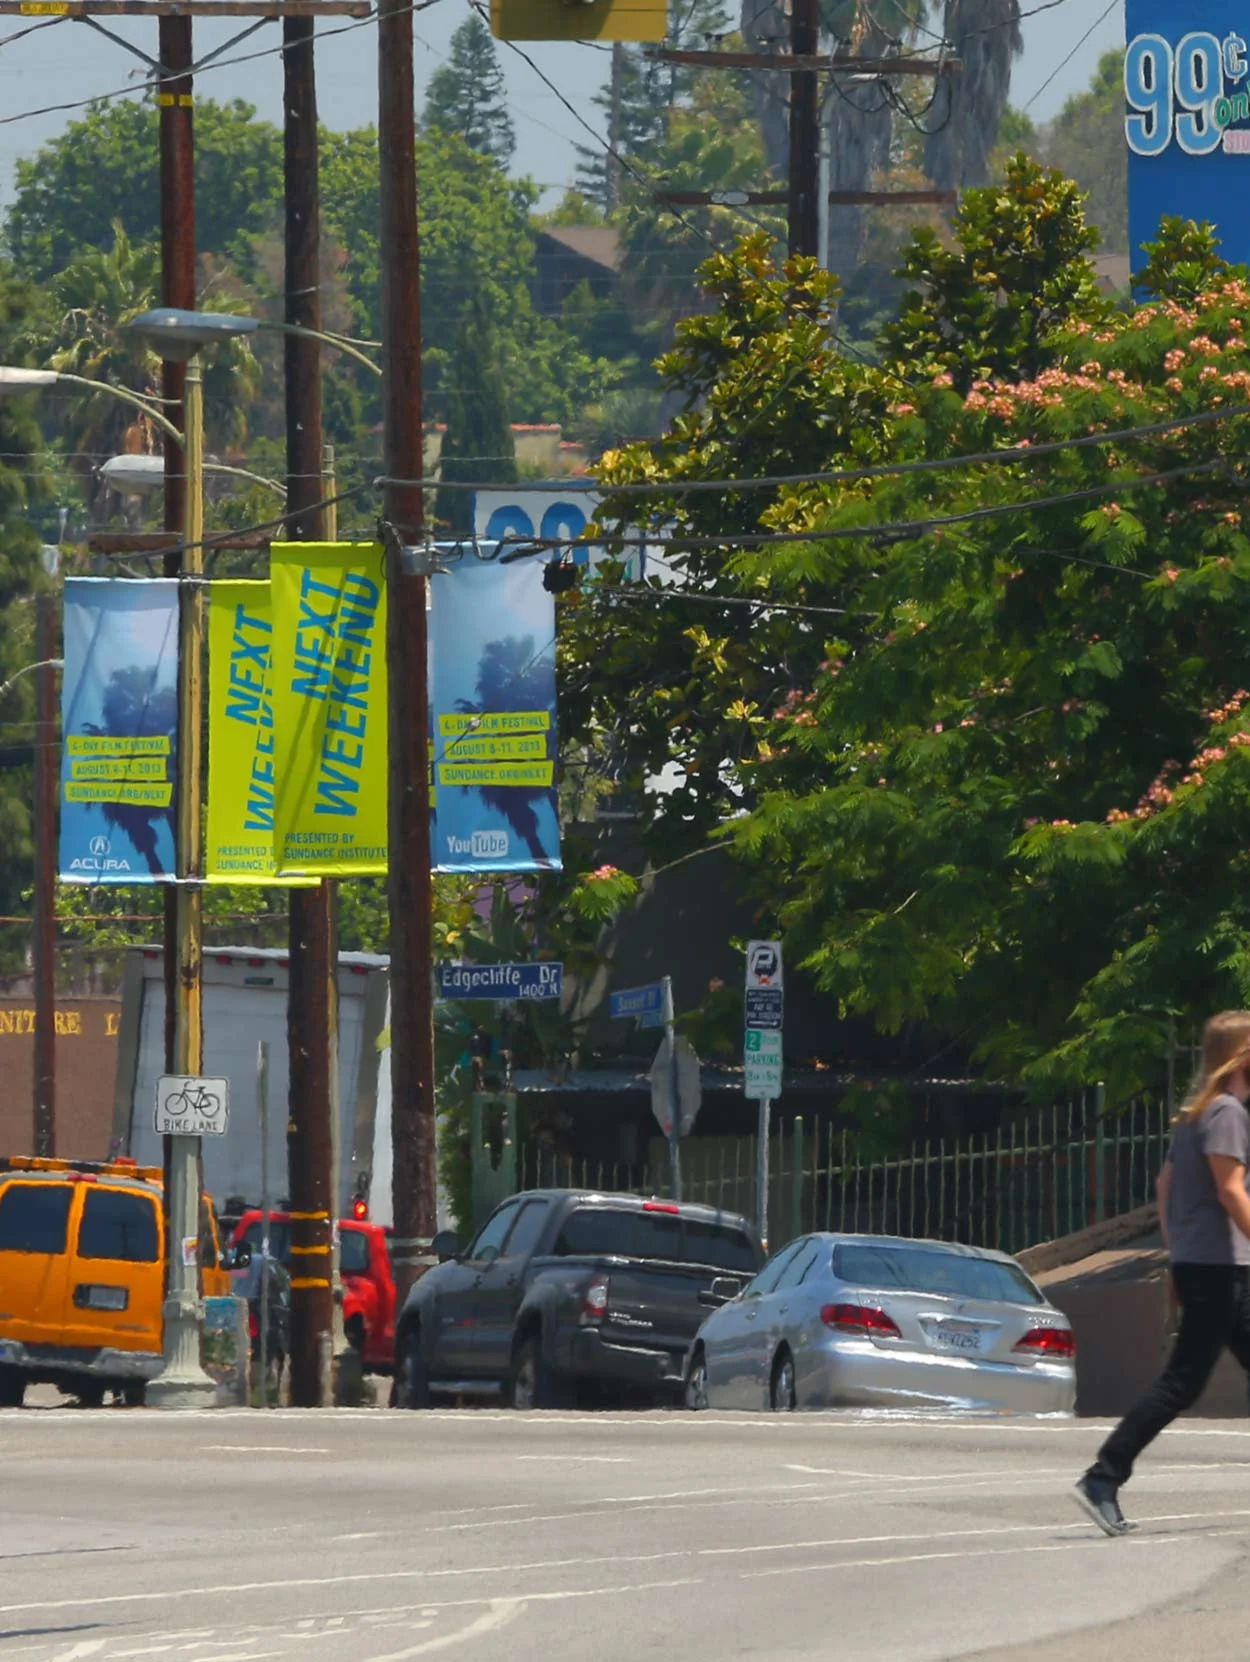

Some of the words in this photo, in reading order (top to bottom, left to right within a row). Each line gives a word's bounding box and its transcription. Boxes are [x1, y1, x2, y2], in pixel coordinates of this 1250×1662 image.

[291, 567, 343, 701] NEXT
[225, 603, 273, 725] NEXT
[313, 572, 380, 817] WEEKEND
[285, 832, 339, 844] PRESENTED
[447, 831, 509, 857] YouTube
[284, 847, 334, 860] SUNDANCE
[69, 858, 131, 870] ACURA
[540, 966, 558, 983] Dr
[520, 984, 545, 997] 1400
[549, 983, 558, 994] N
[164, 1118, 189, 1130] BIKE
[193, 1120, 217, 1131] LANE
